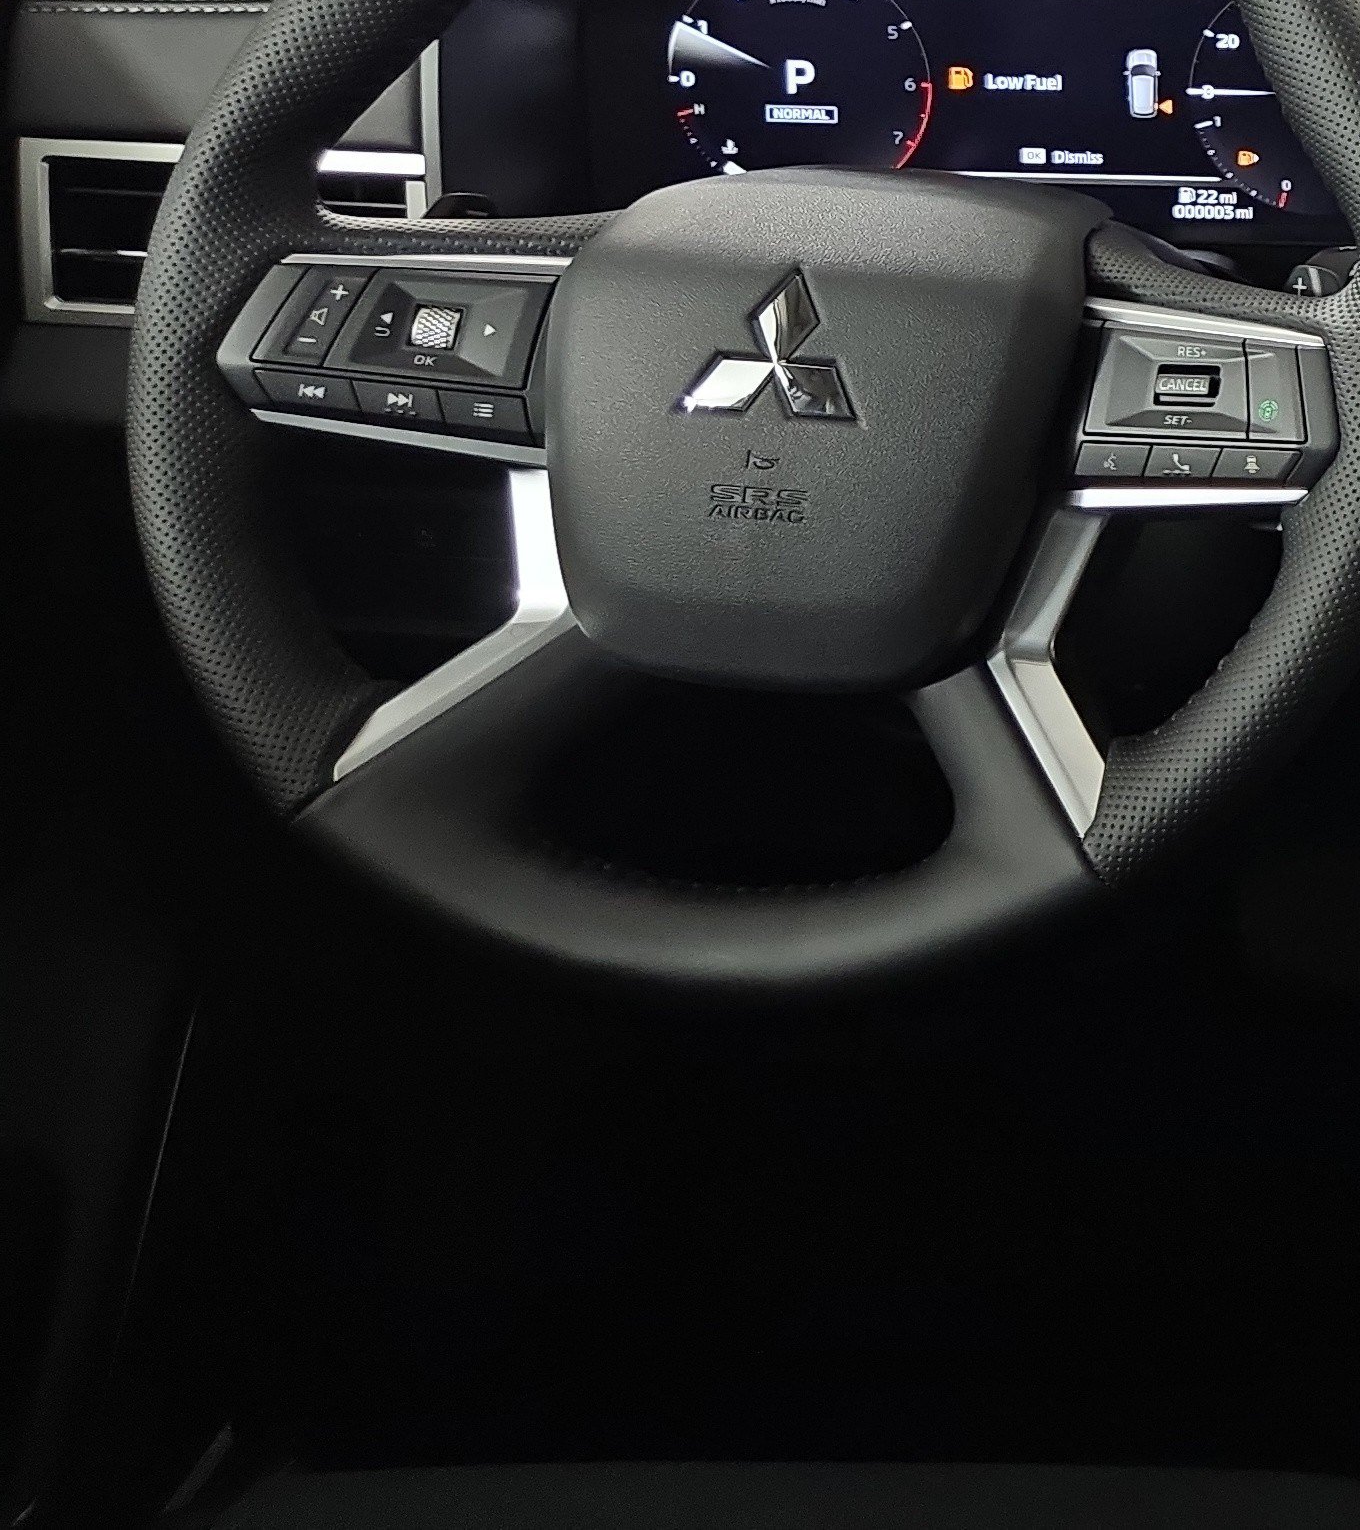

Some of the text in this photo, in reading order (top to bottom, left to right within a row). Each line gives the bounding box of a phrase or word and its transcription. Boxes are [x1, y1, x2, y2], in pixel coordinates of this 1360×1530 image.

[887, 25, 898, 40] 5
[1215, 33, 1240, 49] 20
[679, 70, 696, 88] 0
[785, 58, 816, 95] P
[984, 73, 1063, 91] Low Fuel
[904, 77, 916, 92] 6
[693, 103, 705, 115] H
[772, 107, 830, 120] NORMAL
[892, 130, 903, 145] 7
[1026, 150, 1104, 165] OK Dismiss
[1280, 179, 1291, 192] 0
[1196, 189, 1237, 204] 22 mi
[1172, 204, 1254, 220] 000003 mi
[413, 354, 438, 367] OK
[1158, 378, 1208, 392] CANCEL
[711, 483, 809, 507] SRS
[708, 504, 806, 524] AIRBAG
